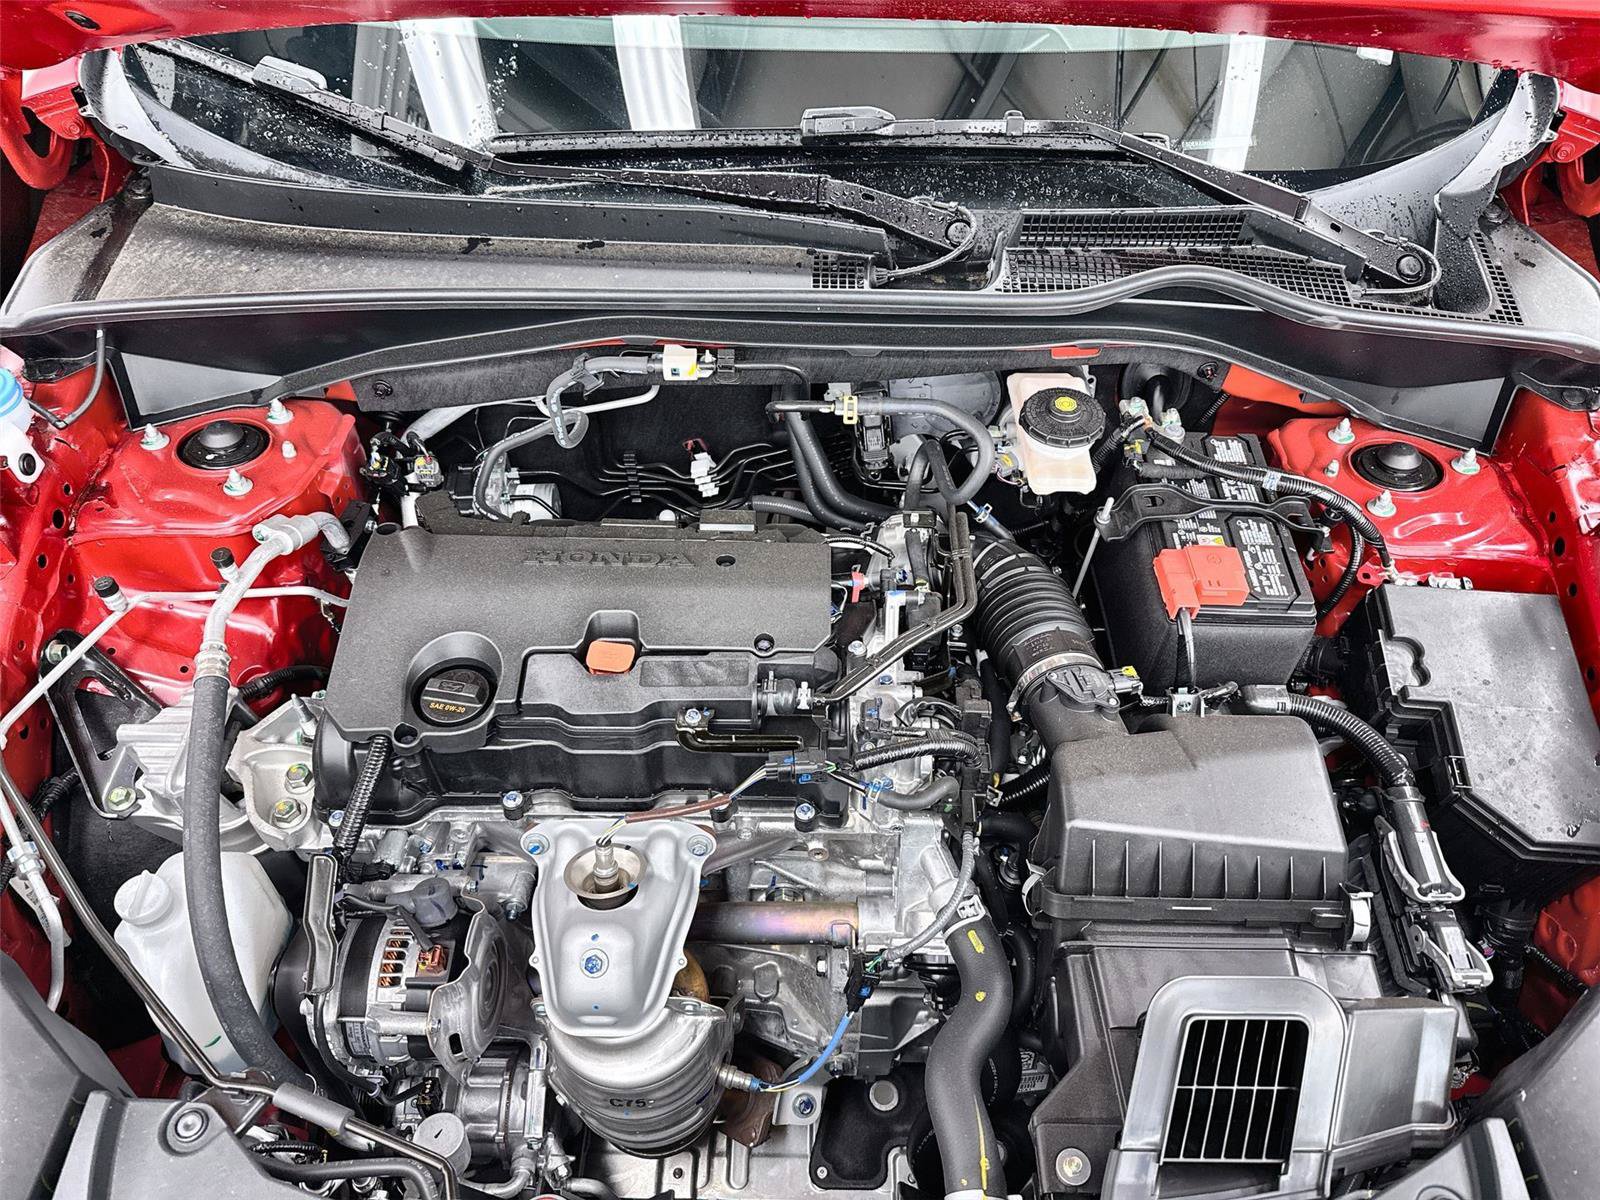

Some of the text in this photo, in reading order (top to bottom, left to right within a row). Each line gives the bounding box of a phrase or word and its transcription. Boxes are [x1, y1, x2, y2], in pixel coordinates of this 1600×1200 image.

[523, 550, 696, 567] HONDA
[429, 702, 466, 713] SAE 0W-20
